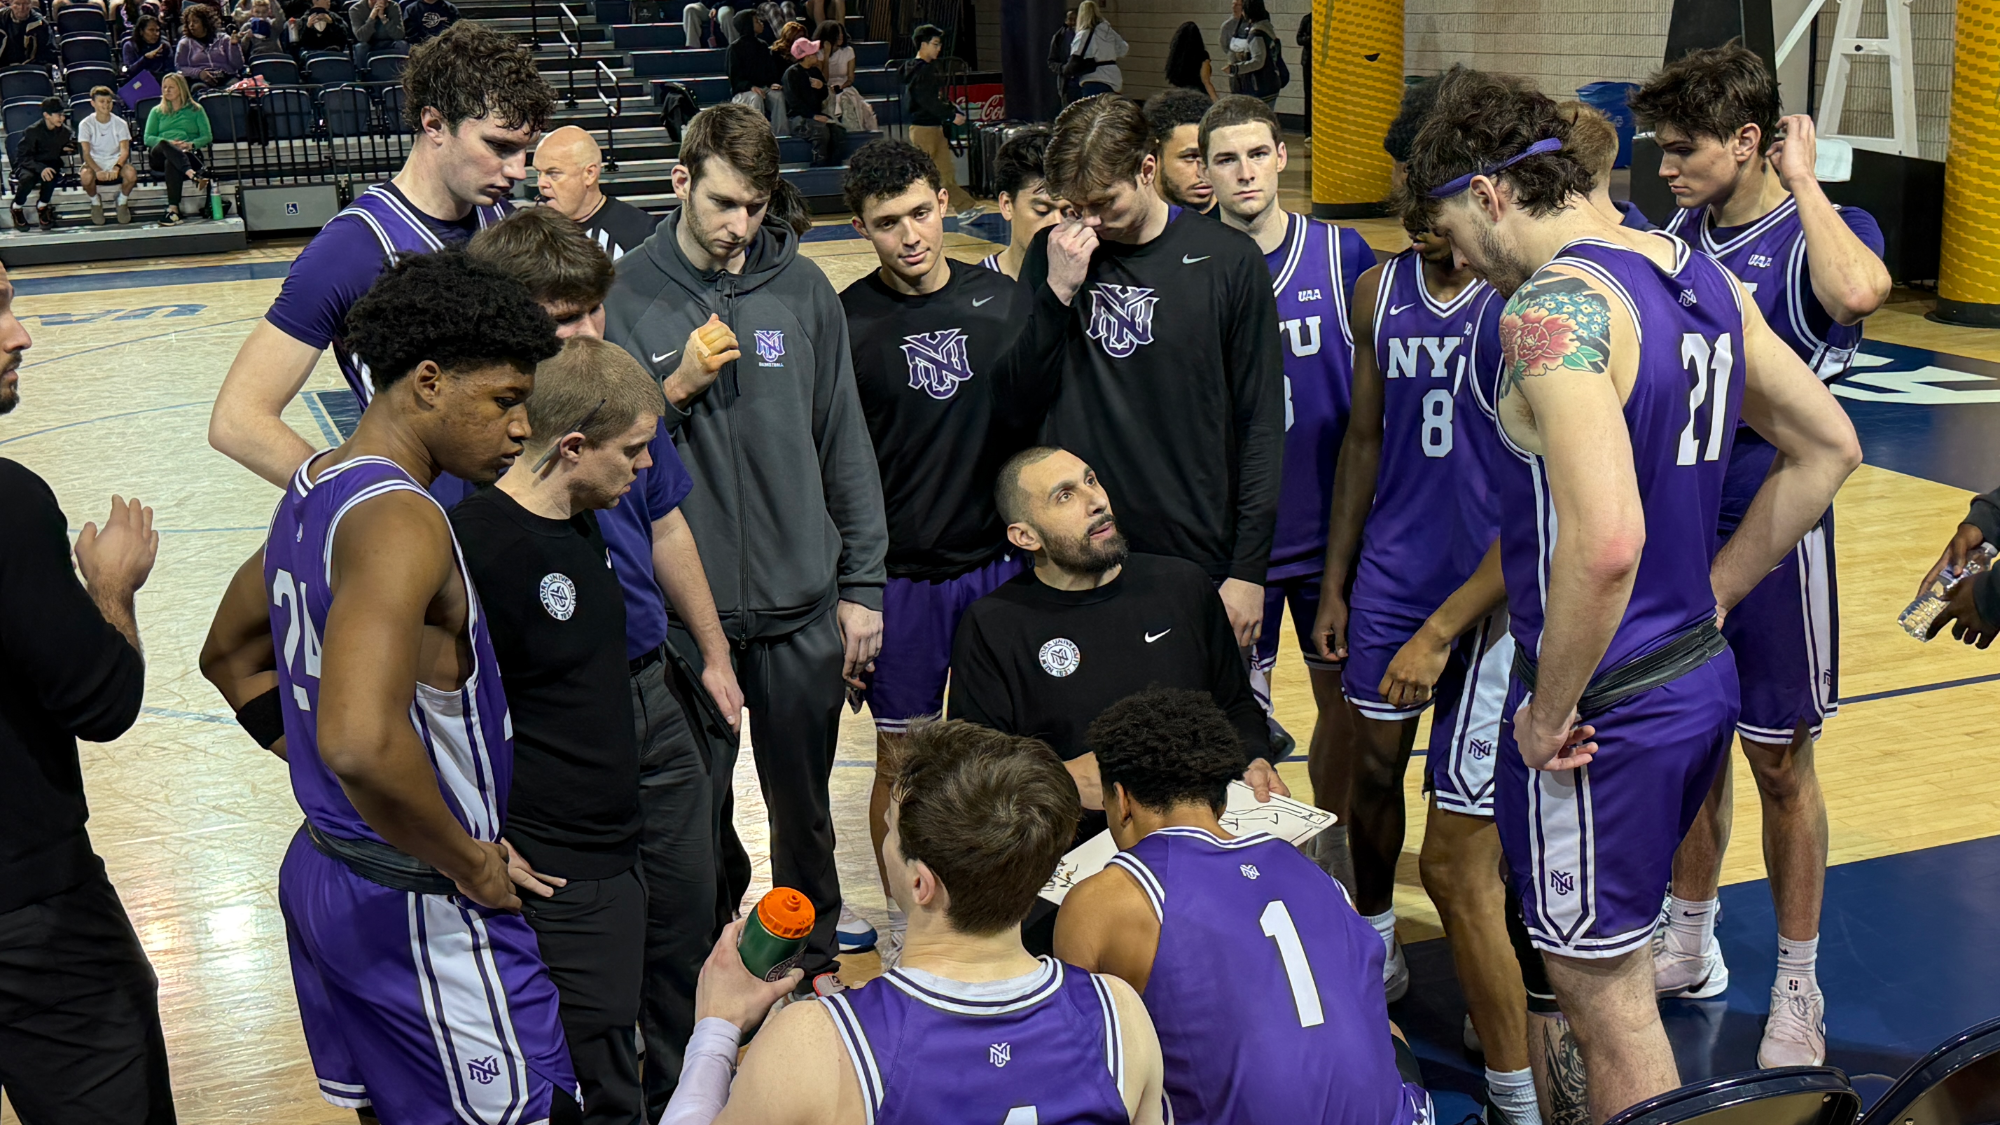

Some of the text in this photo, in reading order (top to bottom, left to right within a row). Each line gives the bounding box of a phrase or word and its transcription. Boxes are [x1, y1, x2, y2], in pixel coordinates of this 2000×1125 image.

[1298, 289, 1322, 302] UAA
[1279, 316, 1321, 357] U
[1387, 336, 1464, 378] NY
[1421, 389, 1453, 457] 8
[1676, 332, 1733, 465] 21
[273, 568, 322, 711] 24
[1259, 900, 1325, 1028] 1
